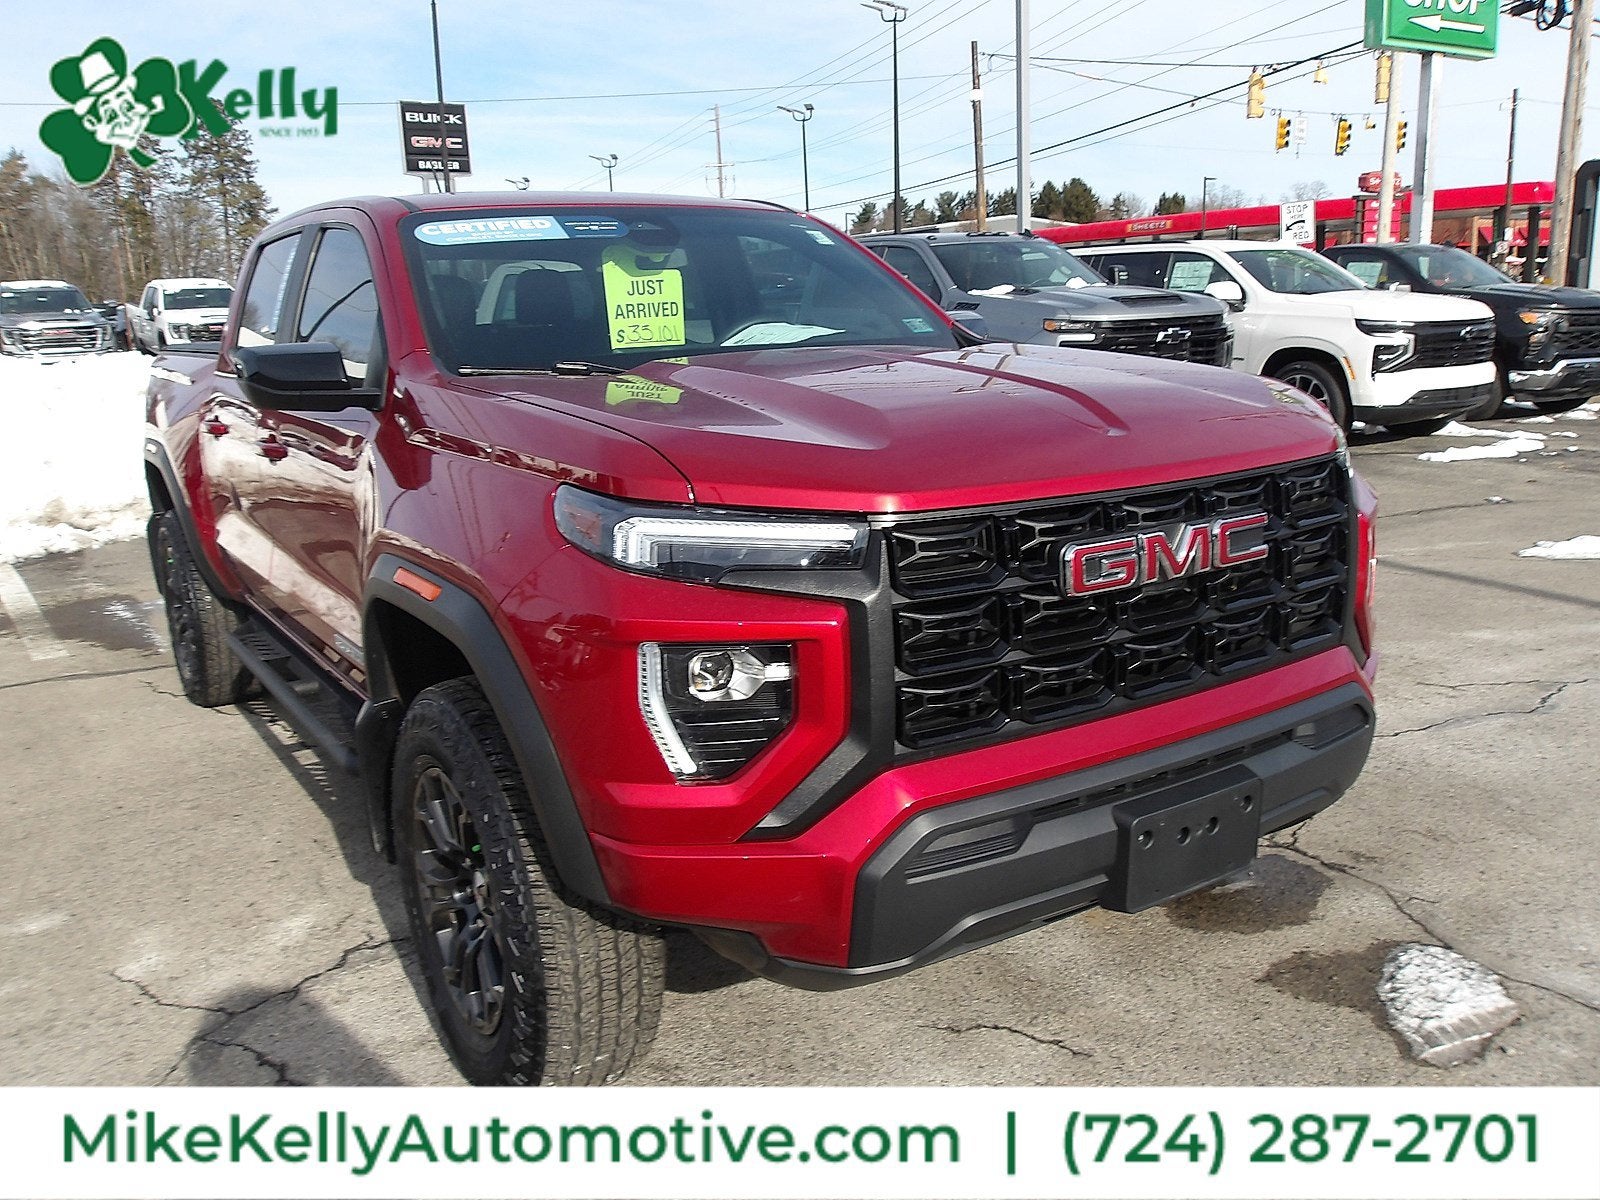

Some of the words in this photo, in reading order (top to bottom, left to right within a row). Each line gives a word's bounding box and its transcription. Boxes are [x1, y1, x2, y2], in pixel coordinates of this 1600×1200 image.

[405, 112, 463, 124] BUICK
[411, 136, 463, 149] GMC
[1286, 204, 1308, 214] STOP
[421, 219, 552, 235] CERTIFIED
[1293, 231, 1310, 240] RED
[627, 280, 664, 295] JUST
[615, 302, 679, 319] ARRIVED
[1063, 512, 1269, 597] GMC
